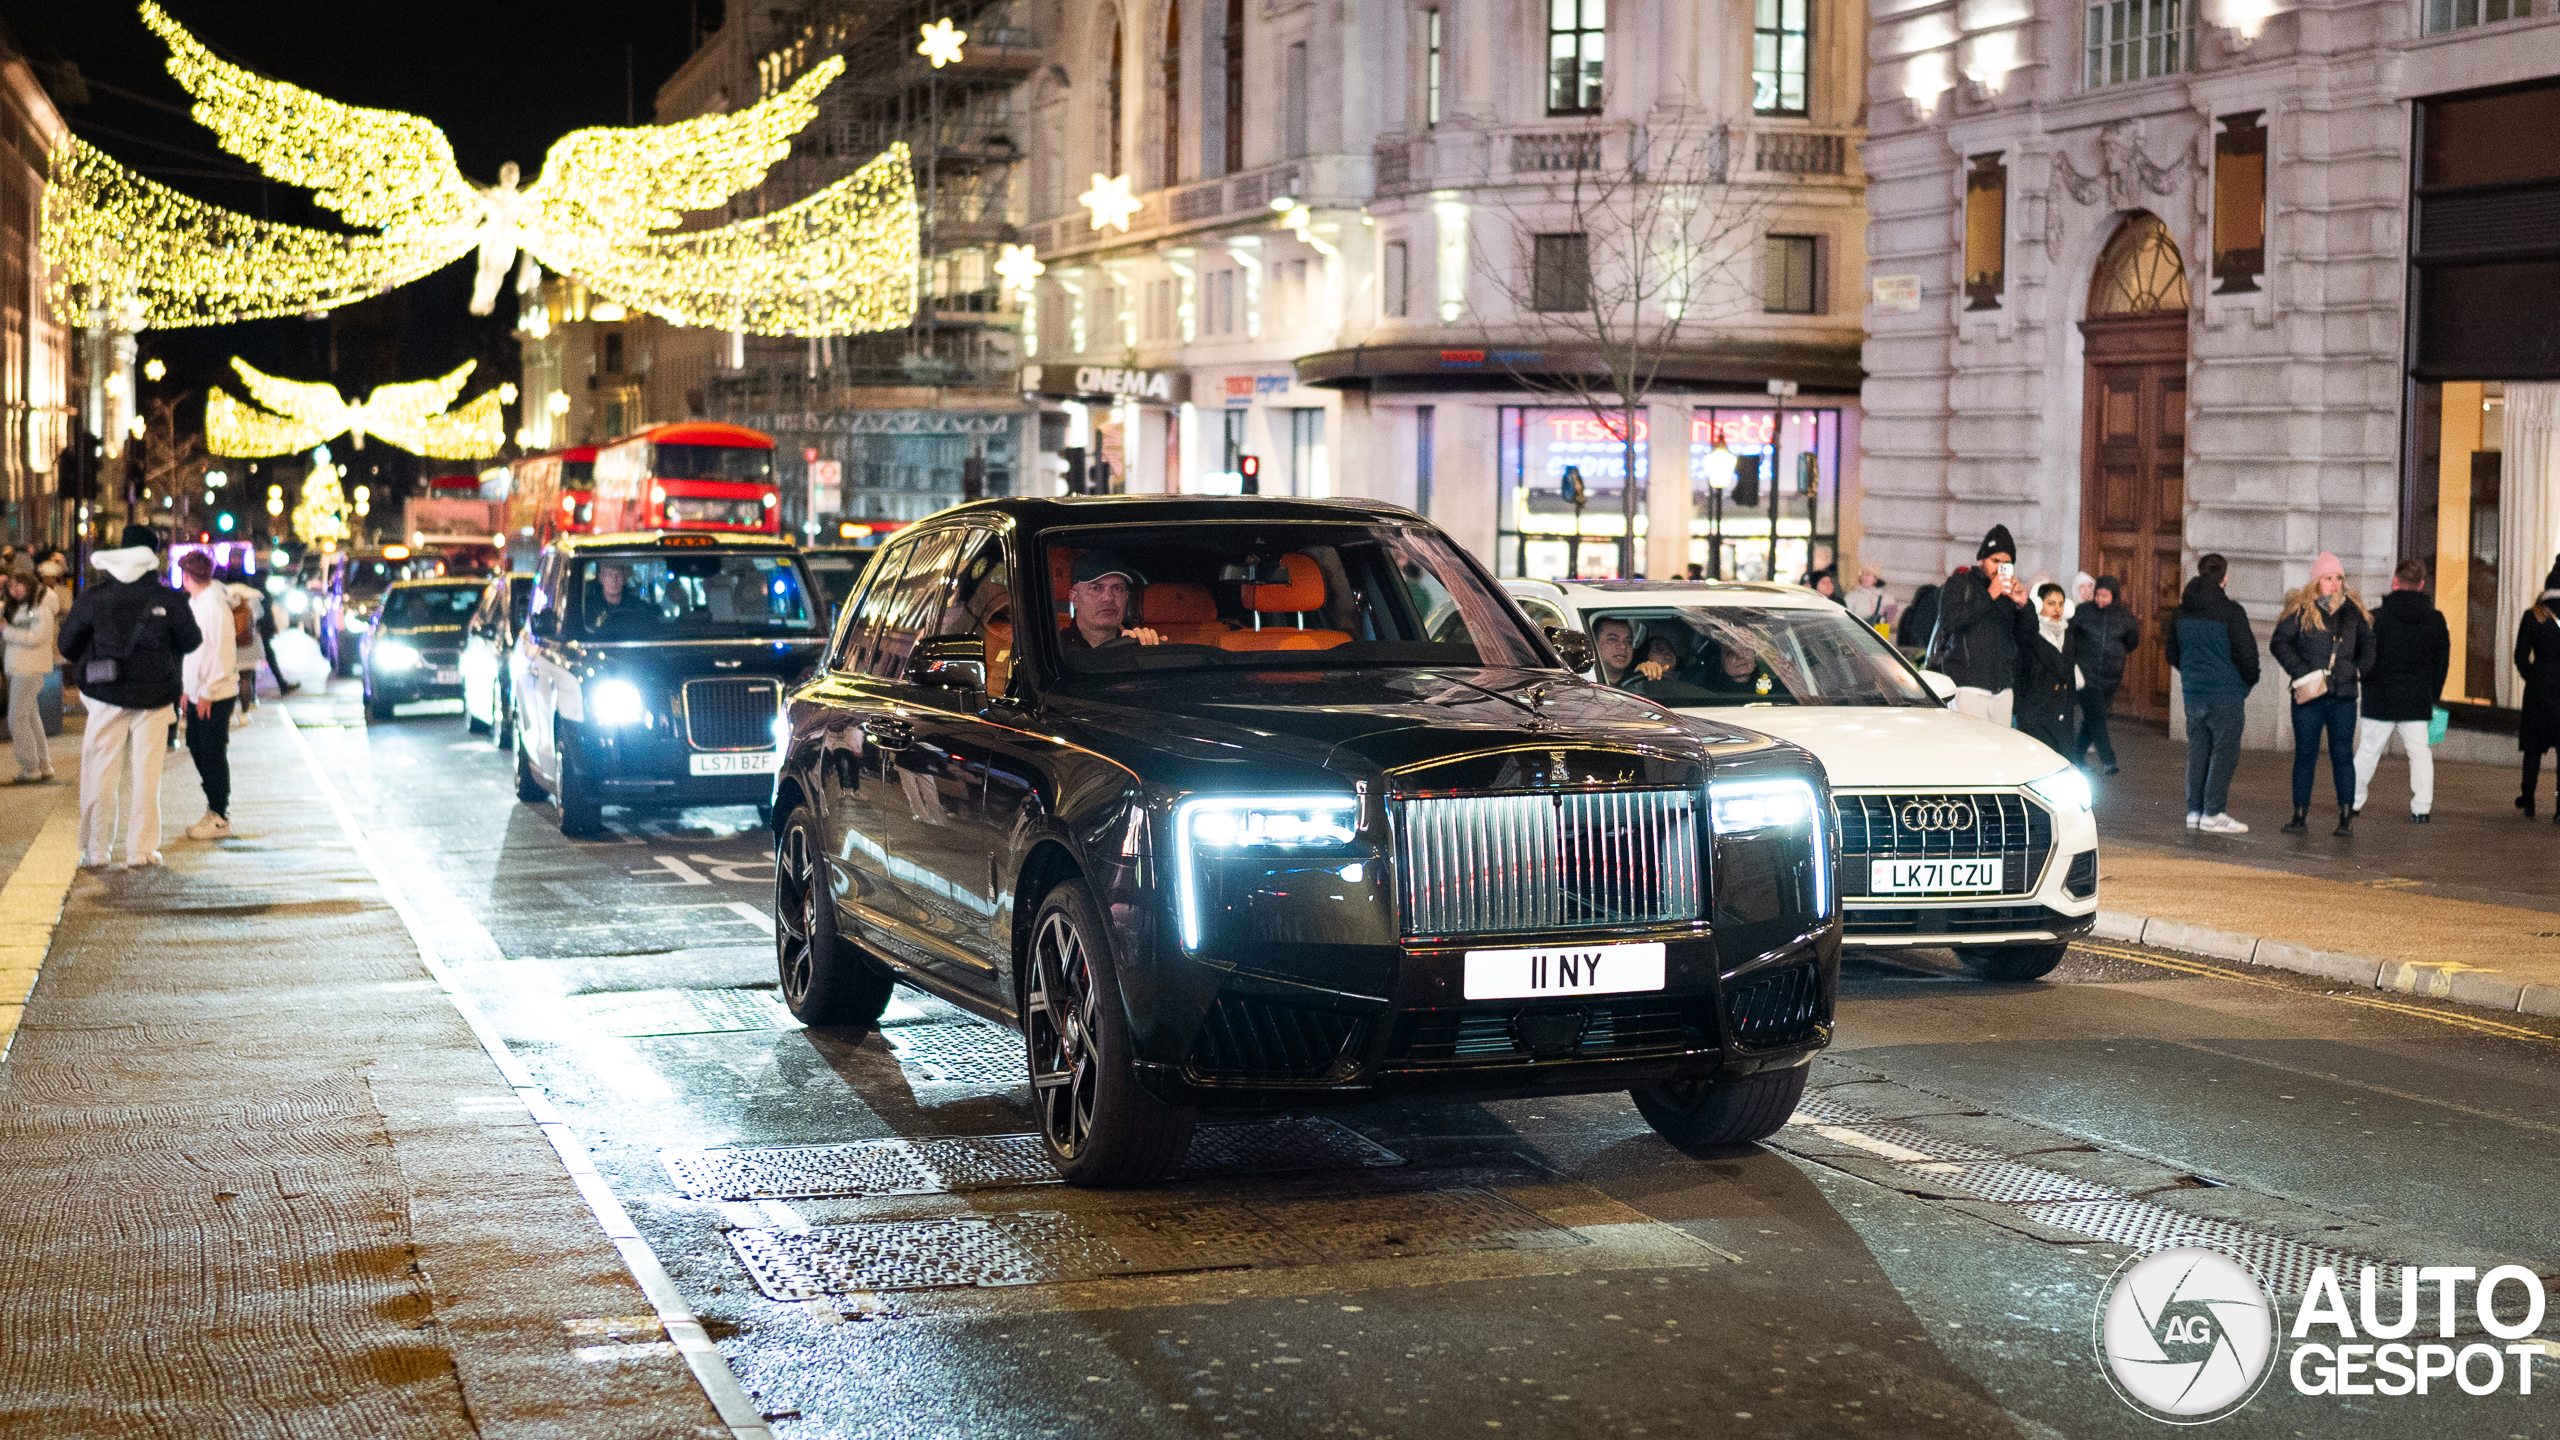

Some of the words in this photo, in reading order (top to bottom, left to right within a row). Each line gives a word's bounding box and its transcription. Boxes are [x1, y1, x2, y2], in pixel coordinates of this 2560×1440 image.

[1074, 367, 1171, 399] CINEMA
[1547, 418, 1649, 442] TESCO
[701, 756, 736, 771] LS71
[741, 755, 770, 770] BZF
[1893, 865, 1943, 887] LK71
[1951, 864, 1993, 886] CZU
[1559, 953, 1602, 988] NY
